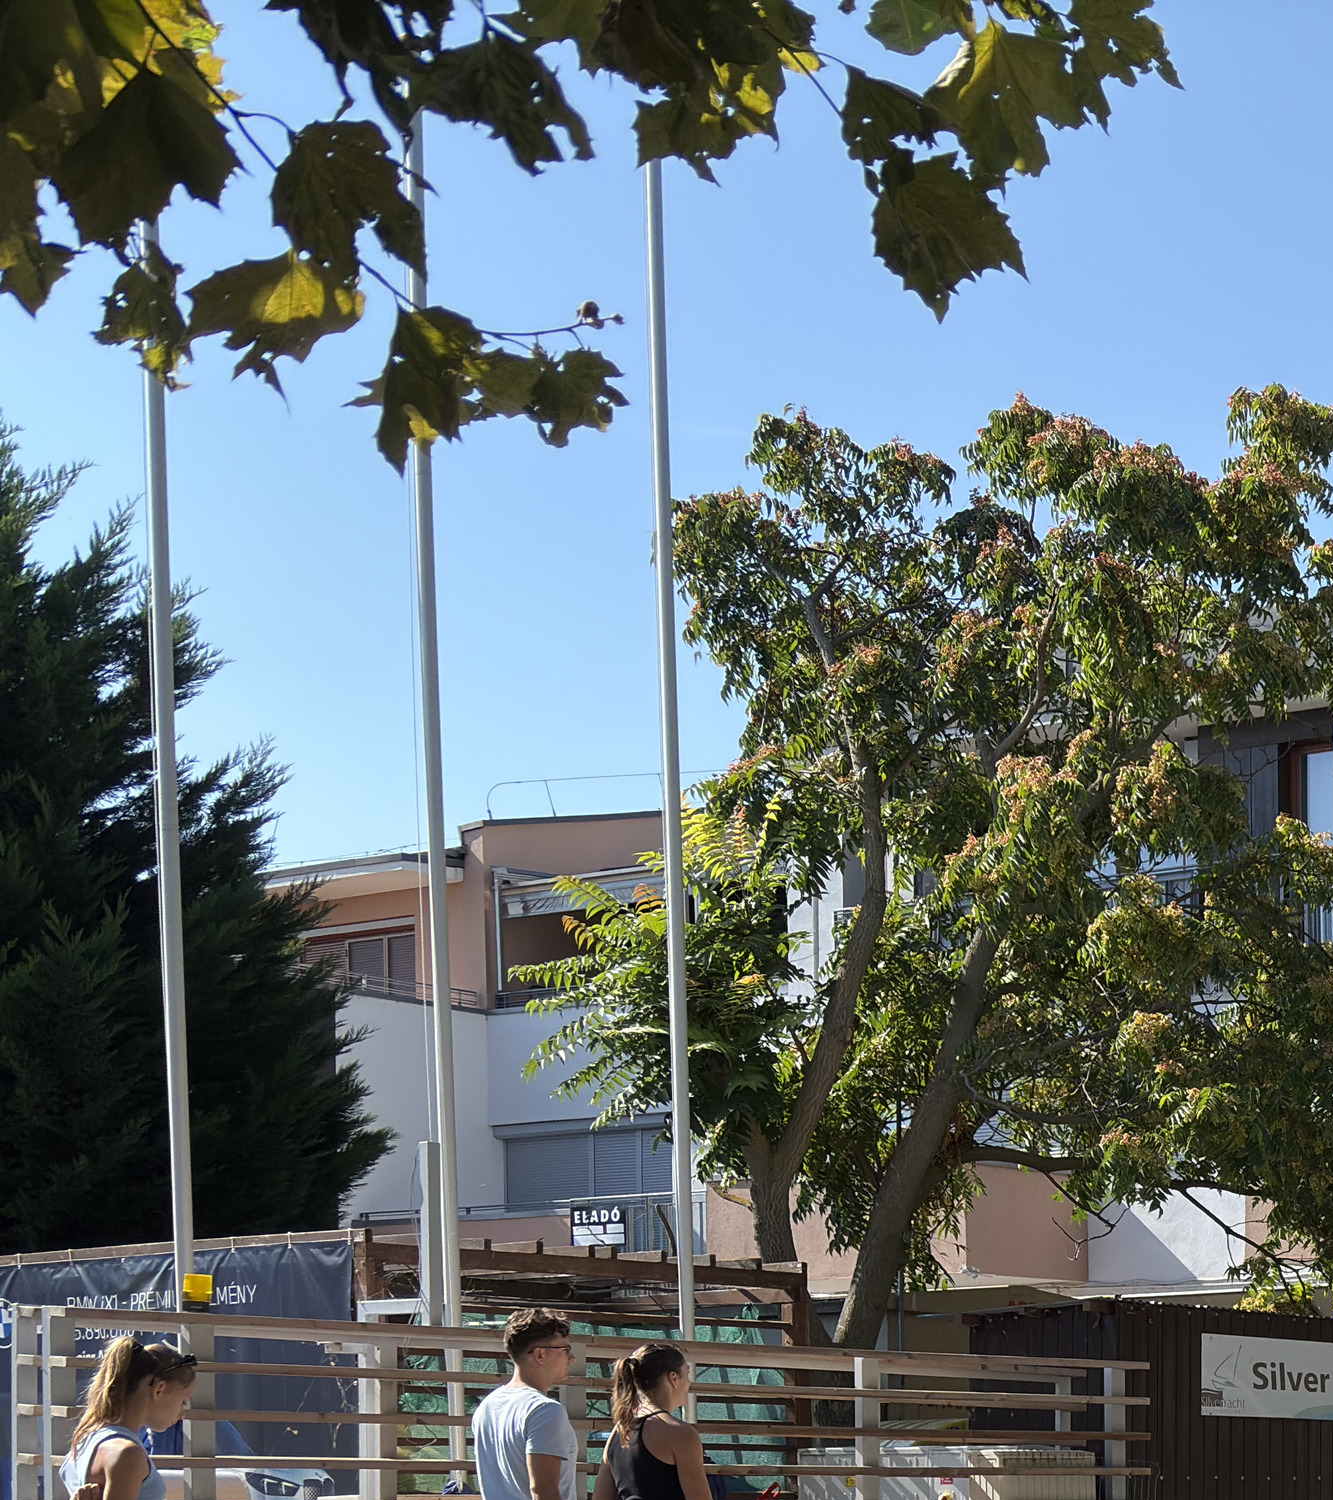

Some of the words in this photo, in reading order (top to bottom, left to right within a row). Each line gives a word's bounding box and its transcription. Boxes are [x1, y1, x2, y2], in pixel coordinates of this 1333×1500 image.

[573, 1206, 620, 1224] ELADÓ
[130, 1288, 178, 1311] PRÉMIU
[209, 1281, 258, 1306] MÉNY
[1252, 1361, 1330, 1394] Silver
